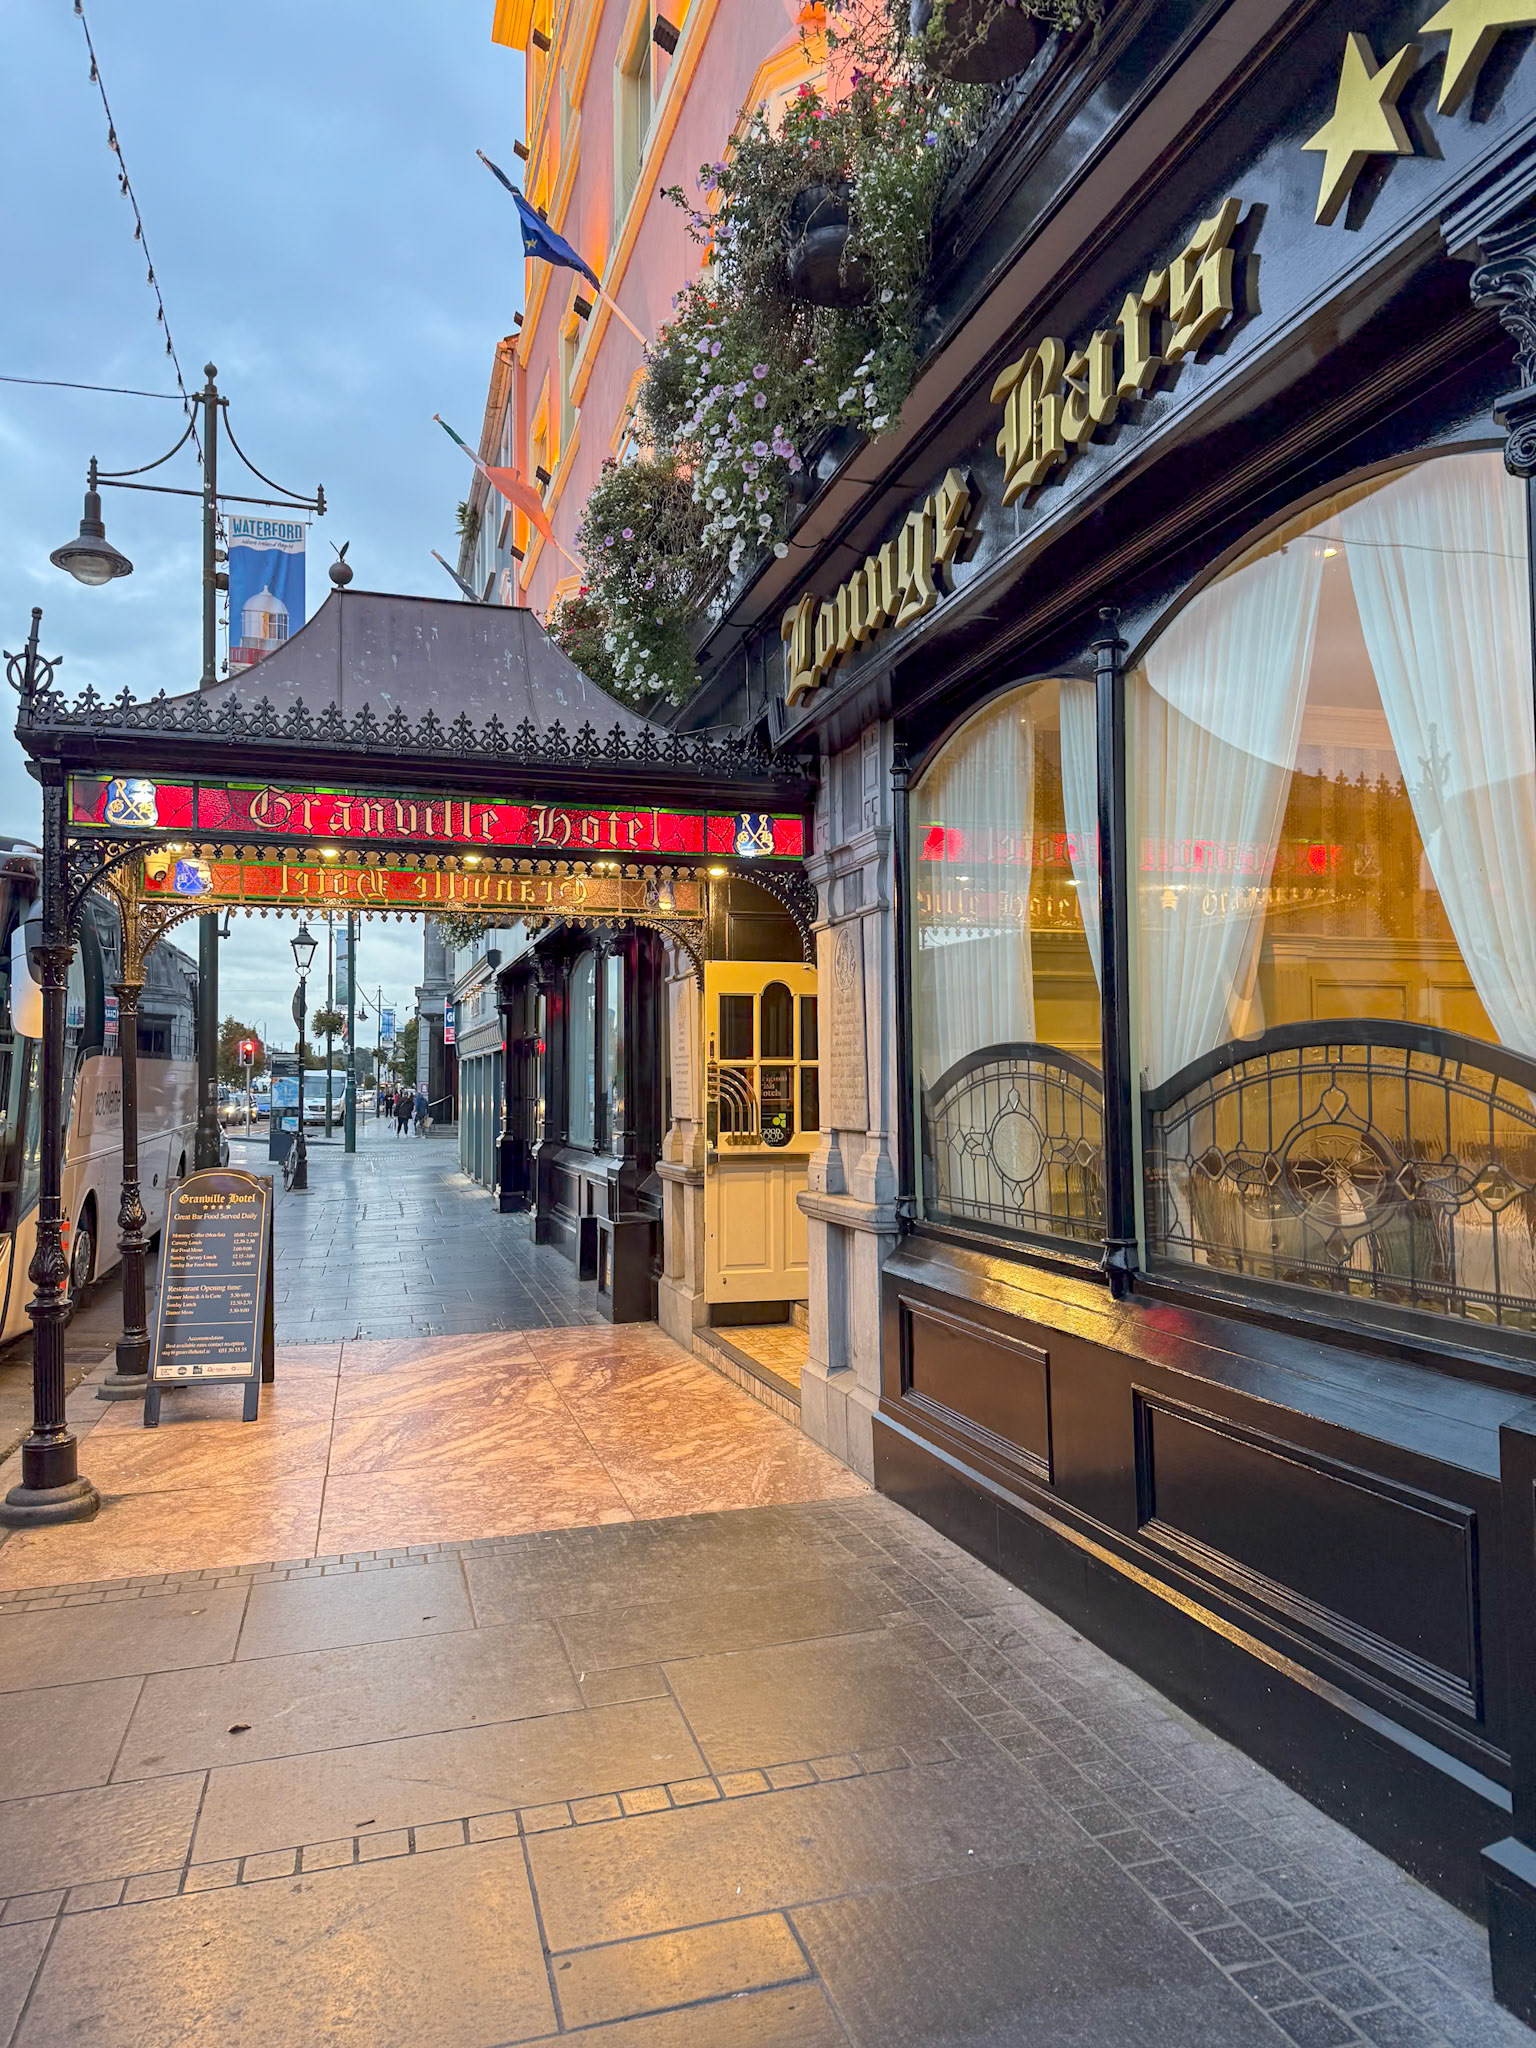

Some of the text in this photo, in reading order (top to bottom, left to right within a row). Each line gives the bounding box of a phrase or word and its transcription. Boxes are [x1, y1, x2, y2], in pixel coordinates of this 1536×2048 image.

[781, 197, 1243, 708] Lounge Bars
[232, 518, 302, 539] WATERFORD
[249, 785, 661, 850] Granville Hotel
[762, 1074, 787, 1082] riginal
[179, 1193, 256, 1204] Granville Hotel
